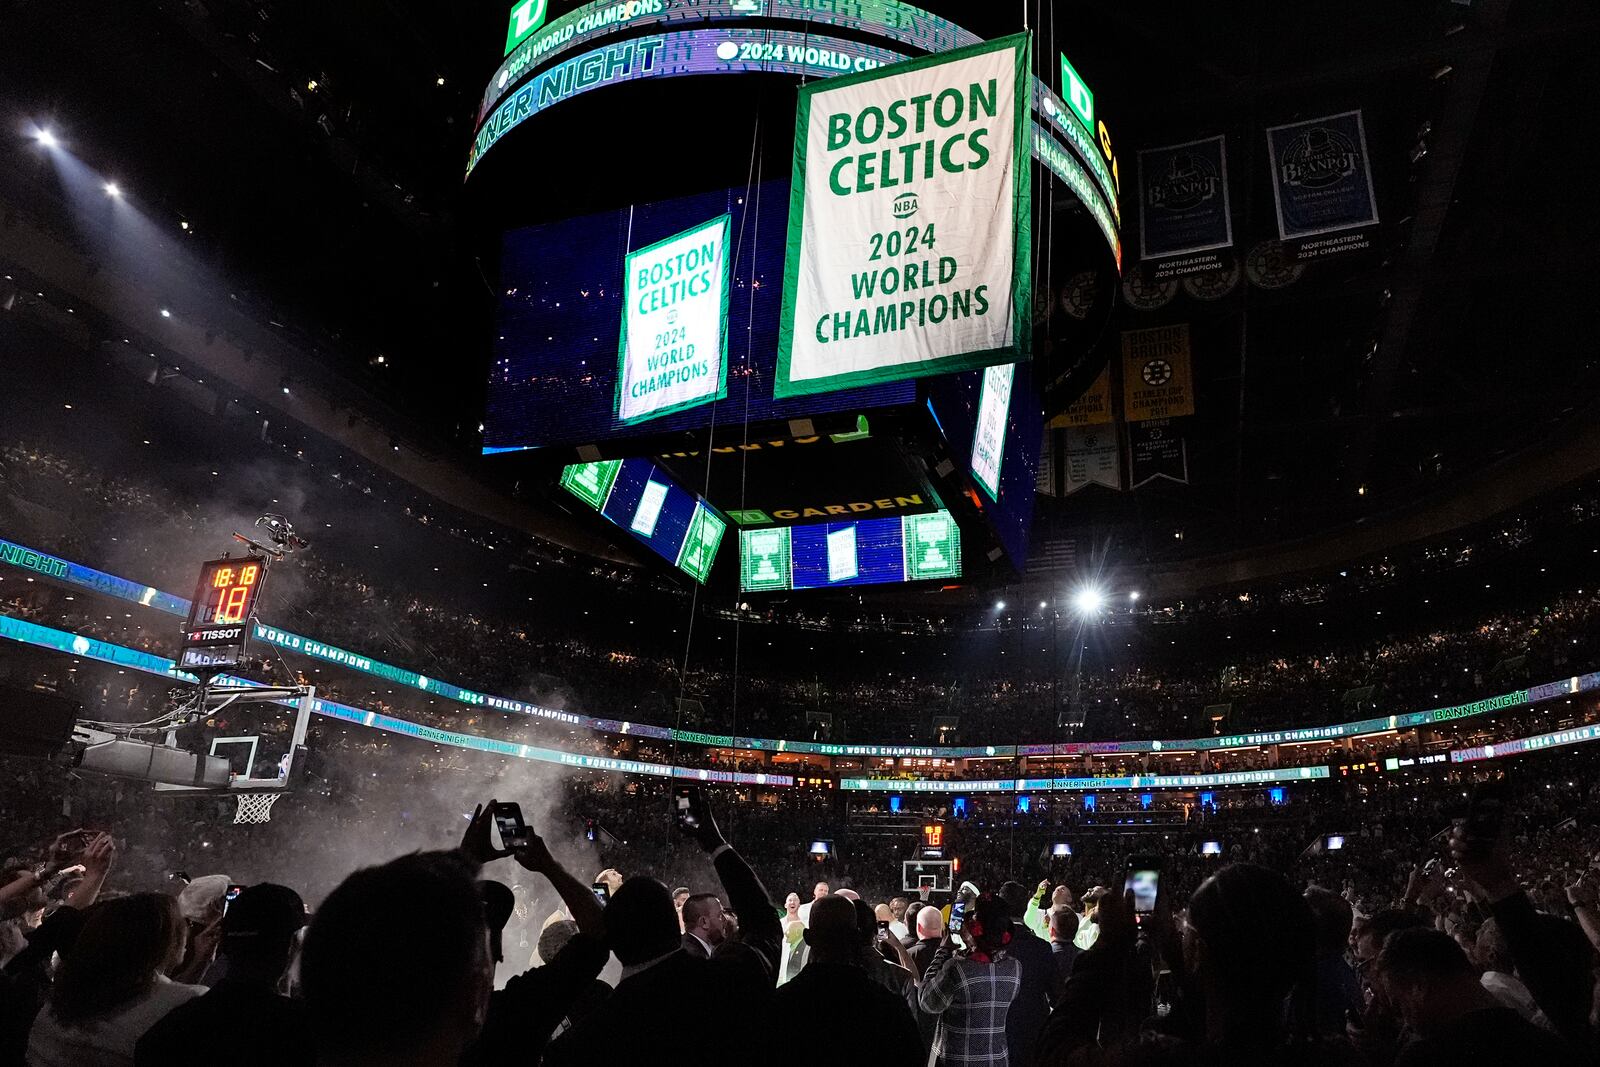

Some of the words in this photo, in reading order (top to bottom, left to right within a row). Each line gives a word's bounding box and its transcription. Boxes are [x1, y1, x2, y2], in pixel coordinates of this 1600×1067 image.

[533, 24, 573, 58] WORLD
[739, 43, 783, 60] 2024
[788, 45, 850, 69] WORLD
[539, 37, 664, 107] NIGHT
[1063, 65, 1091, 121] TD
[828, 78, 997, 152] BOSTON
[829, 128, 989, 196] CELTICS
[893, 198, 918, 212] NBA
[869, 223, 936, 261] 2024
[1297, 249, 1318, 259] 2024
[1320, 241, 1370, 256] CHAMPIONS
[1301, 234, 1364, 251] NORTHEASTERN
[638, 241, 714, 290] BOSTON
[1155, 269, 1174, 278] 2024
[1176, 262, 1223, 275] CHAMPIONS
[1159, 255, 1217, 269] NORTHEASTERN
[852, 256, 957, 300] WORLD
[638, 270, 710, 315] CELTICS
[816, 285, 989, 344] CHAMPIONS
[655, 326, 686, 349] 2024
[1130, 327, 1181, 344] BOSTON
[648, 344, 695, 372] WORLD
[1130, 342, 1182, 358] BRUINS
[632, 360, 709, 398] CHAMPIONS
[1133, 398, 1185, 409] CHAMPIONS
[773, 494, 924, 520] GARDEN
[0, 543, 68, 577] NIGHT
[214, 566, 257, 588] 18:18
[214, 587, 248, 623] 18
[202, 628, 241, 640] TISSOT
[258, 626, 300, 648] WORLD
[304, 641, 371, 670] CHAMPIONS
[458, 690, 484, 704] 2024
[487, 697, 521, 711] WORLD
[525, 706, 579, 723] CHAMPIONS
[1434, 702, 1487, 720] BANNER
[1489, 691, 1528, 710] NIGHT
[418, 728, 444, 741] BANNER
[672, 729, 706, 743] BANNER
[707, 733, 734, 746] NIGHT
[1219, 736, 1244, 746] 2024
[1247, 733, 1281, 743] WORLD
[1285, 727, 1344, 740] CHAMPIONS
[1524, 739, 1550, 750] 2024
[1552, 730, 1590, 744] WORLD
[821, 745, 843, 754] 2024
[847, 746, 878, 755] WORLD
[880, 747, 933, 756] CHAMPIONS
[561, 755, 583, 765] 2024
[586, 758, 617, 769] WORLD
[620, 762, 671, 775] CHAMPIONS
[888, 782, 911, 790] 2024
[915, 781, 944, 791] WORLD
[948, 781, 1000, 791] CHAMPIONS
[1046, 781, 1081, 789] BANNER
[1082, 780, 1106, 788] NIGHT
[1154, 776, 1179, 786] 2024
[1181, 775, 1215, 785] WORLD
[1218, 771, 1275, 783] CHAMPIONS
[928, 833, 940, 845] 18
